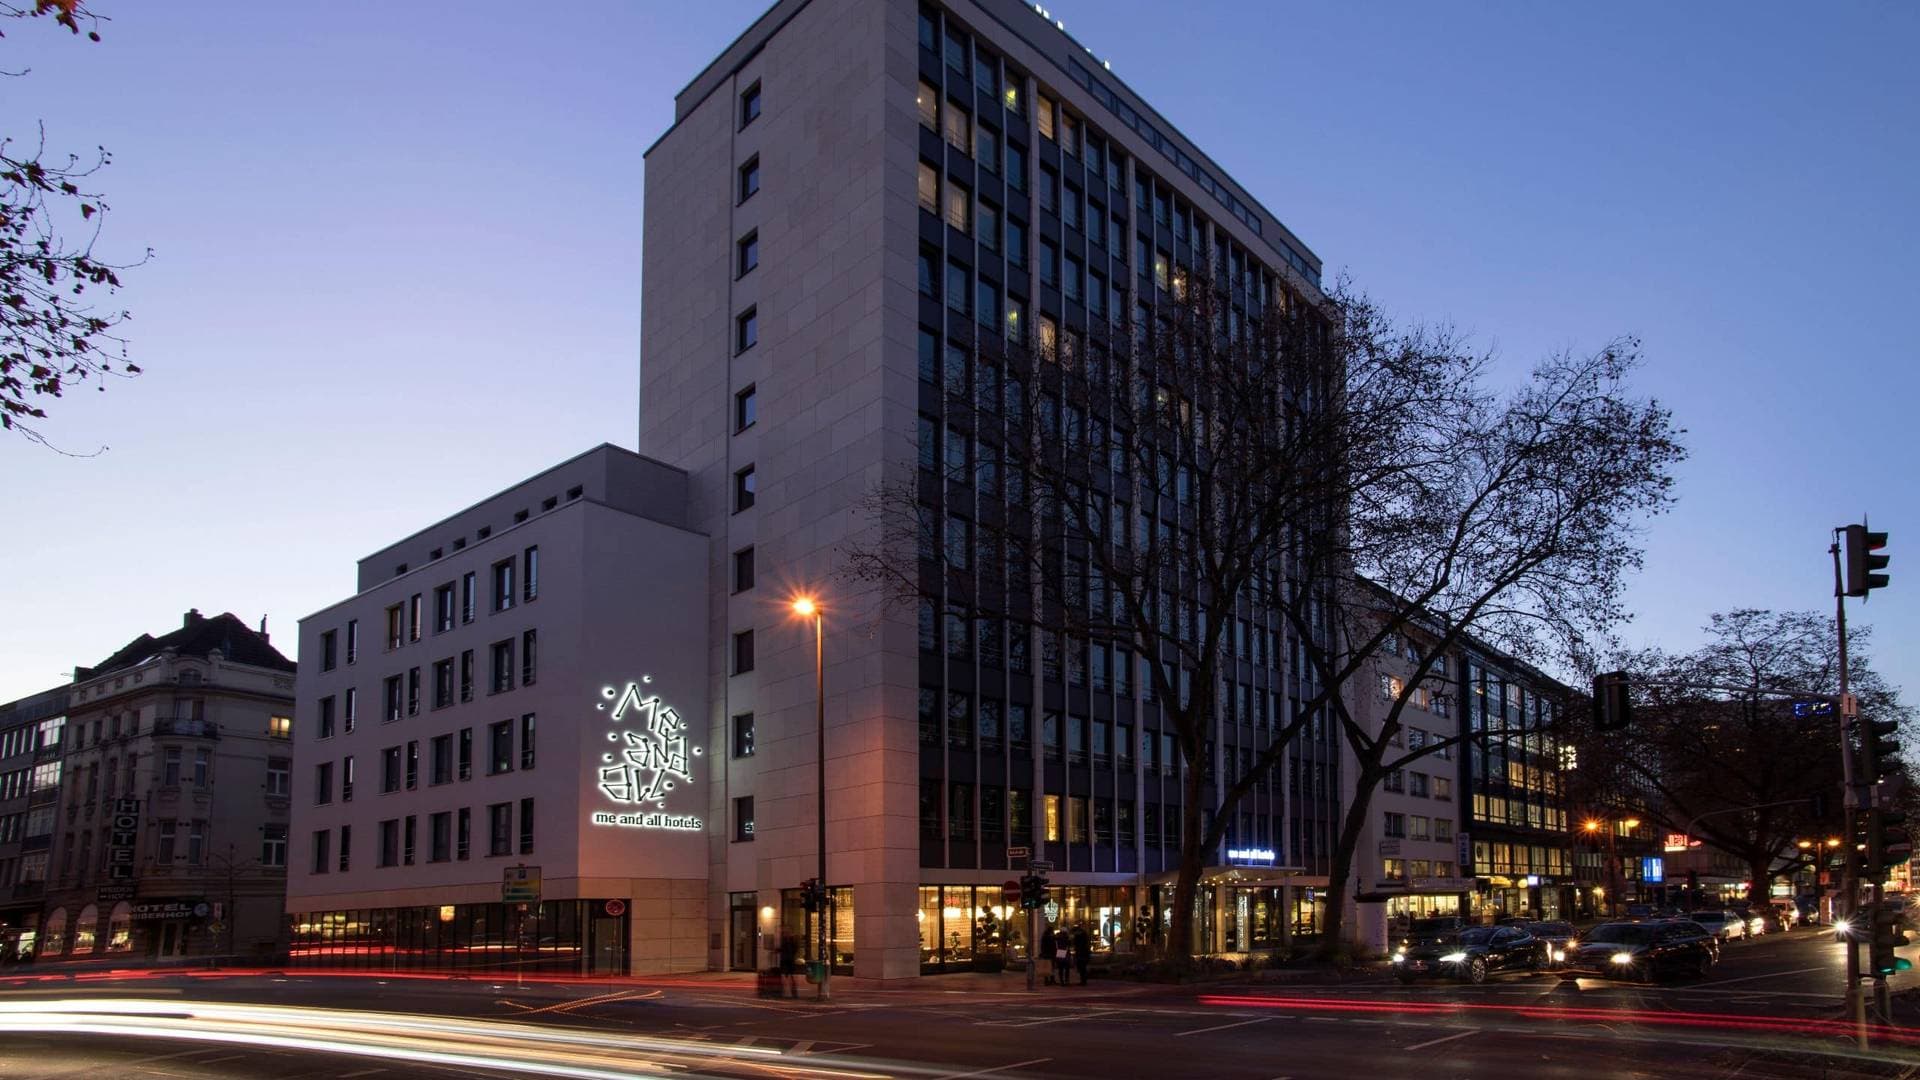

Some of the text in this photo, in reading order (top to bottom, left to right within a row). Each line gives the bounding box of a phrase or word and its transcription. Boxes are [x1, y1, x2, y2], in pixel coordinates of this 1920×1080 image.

[113, 799, 137, 879] HOTEL
[595, 813, 702, 829] me and all hotels
